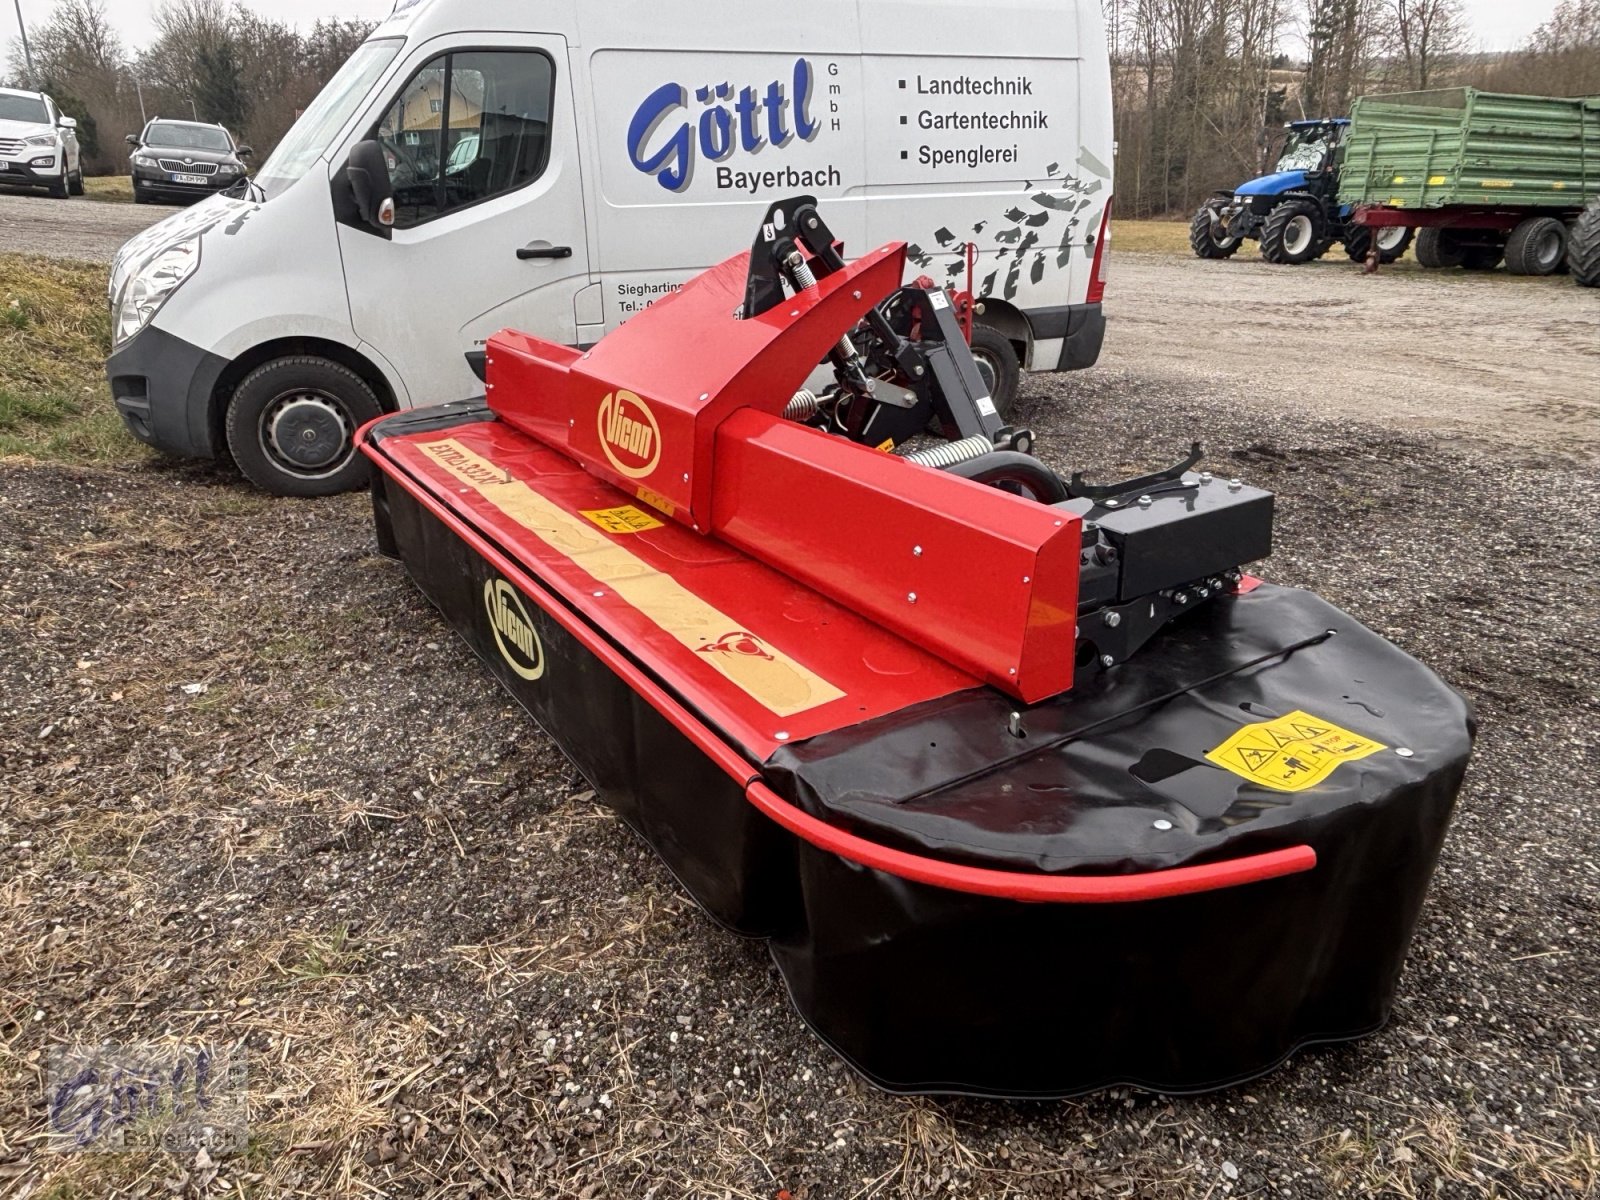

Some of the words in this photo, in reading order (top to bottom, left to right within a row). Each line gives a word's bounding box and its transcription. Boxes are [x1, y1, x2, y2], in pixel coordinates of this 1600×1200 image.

[917, 75, 1033, 96] Landtechnik
[627, 57, 820, 193] Göttl
[918, 109, 1049, 131] Gartentechnik
[918, 145, 1018, 167] Spenglerei
[717, 165, 841, 194] Bayerbach
[619, 301, 643, 312] Tel.:
[603, 391, 655, 465] Vicon
[428, 444, 470, 467] EXTRA
[488, 578, 538, 667] Vicon
